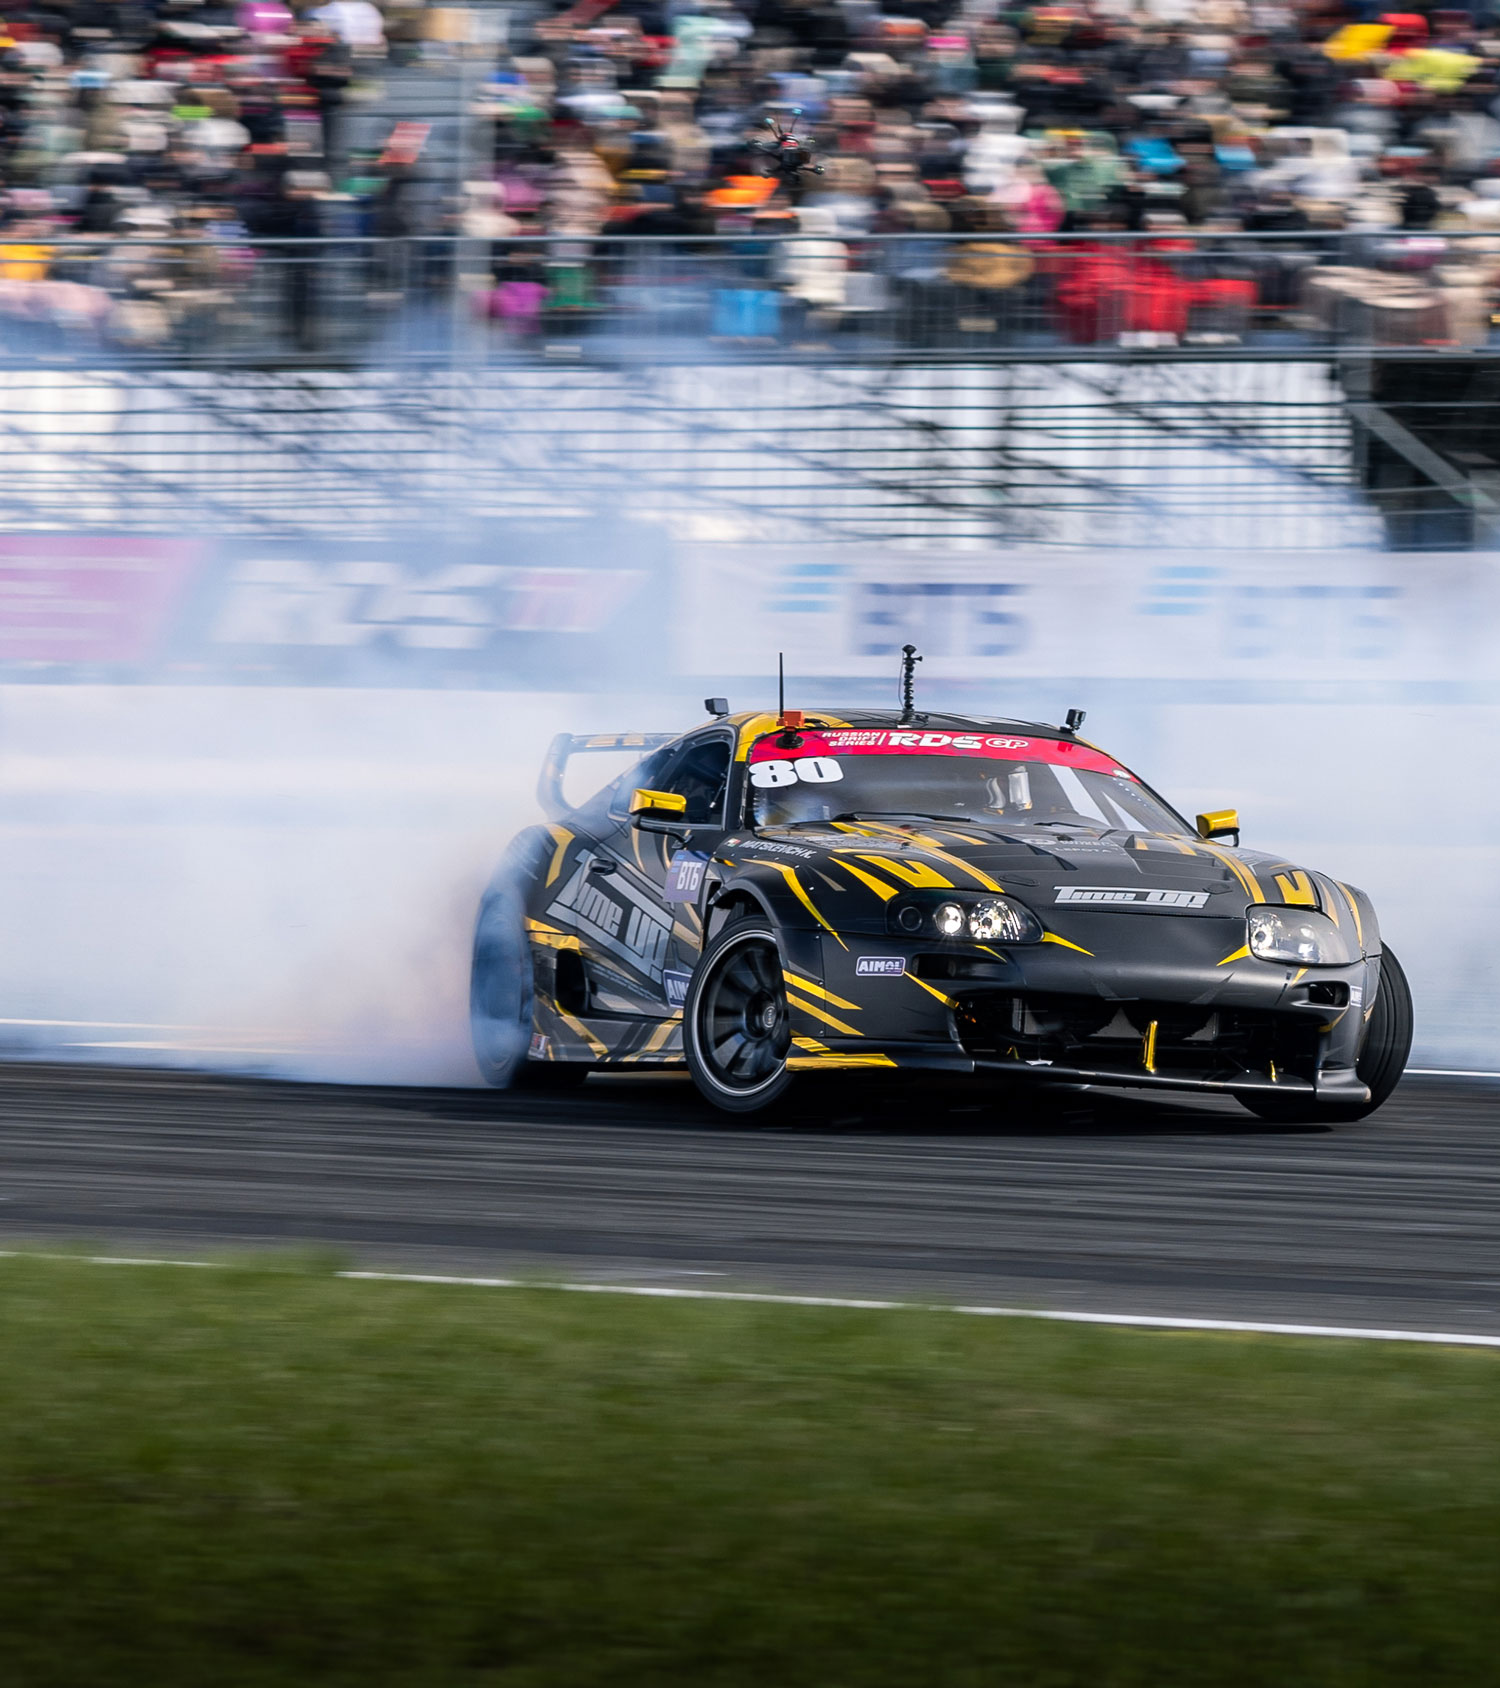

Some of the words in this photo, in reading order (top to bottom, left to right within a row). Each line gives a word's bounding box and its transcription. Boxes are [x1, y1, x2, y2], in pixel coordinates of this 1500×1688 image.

[888, 733, 984, 749] RDS
[987, 737, 1029, 750] GP
[749, 757, 844, 788] 80
[676, 861, 702, 891] ВТБ
[858, 960, 902, 972] AIMOL
